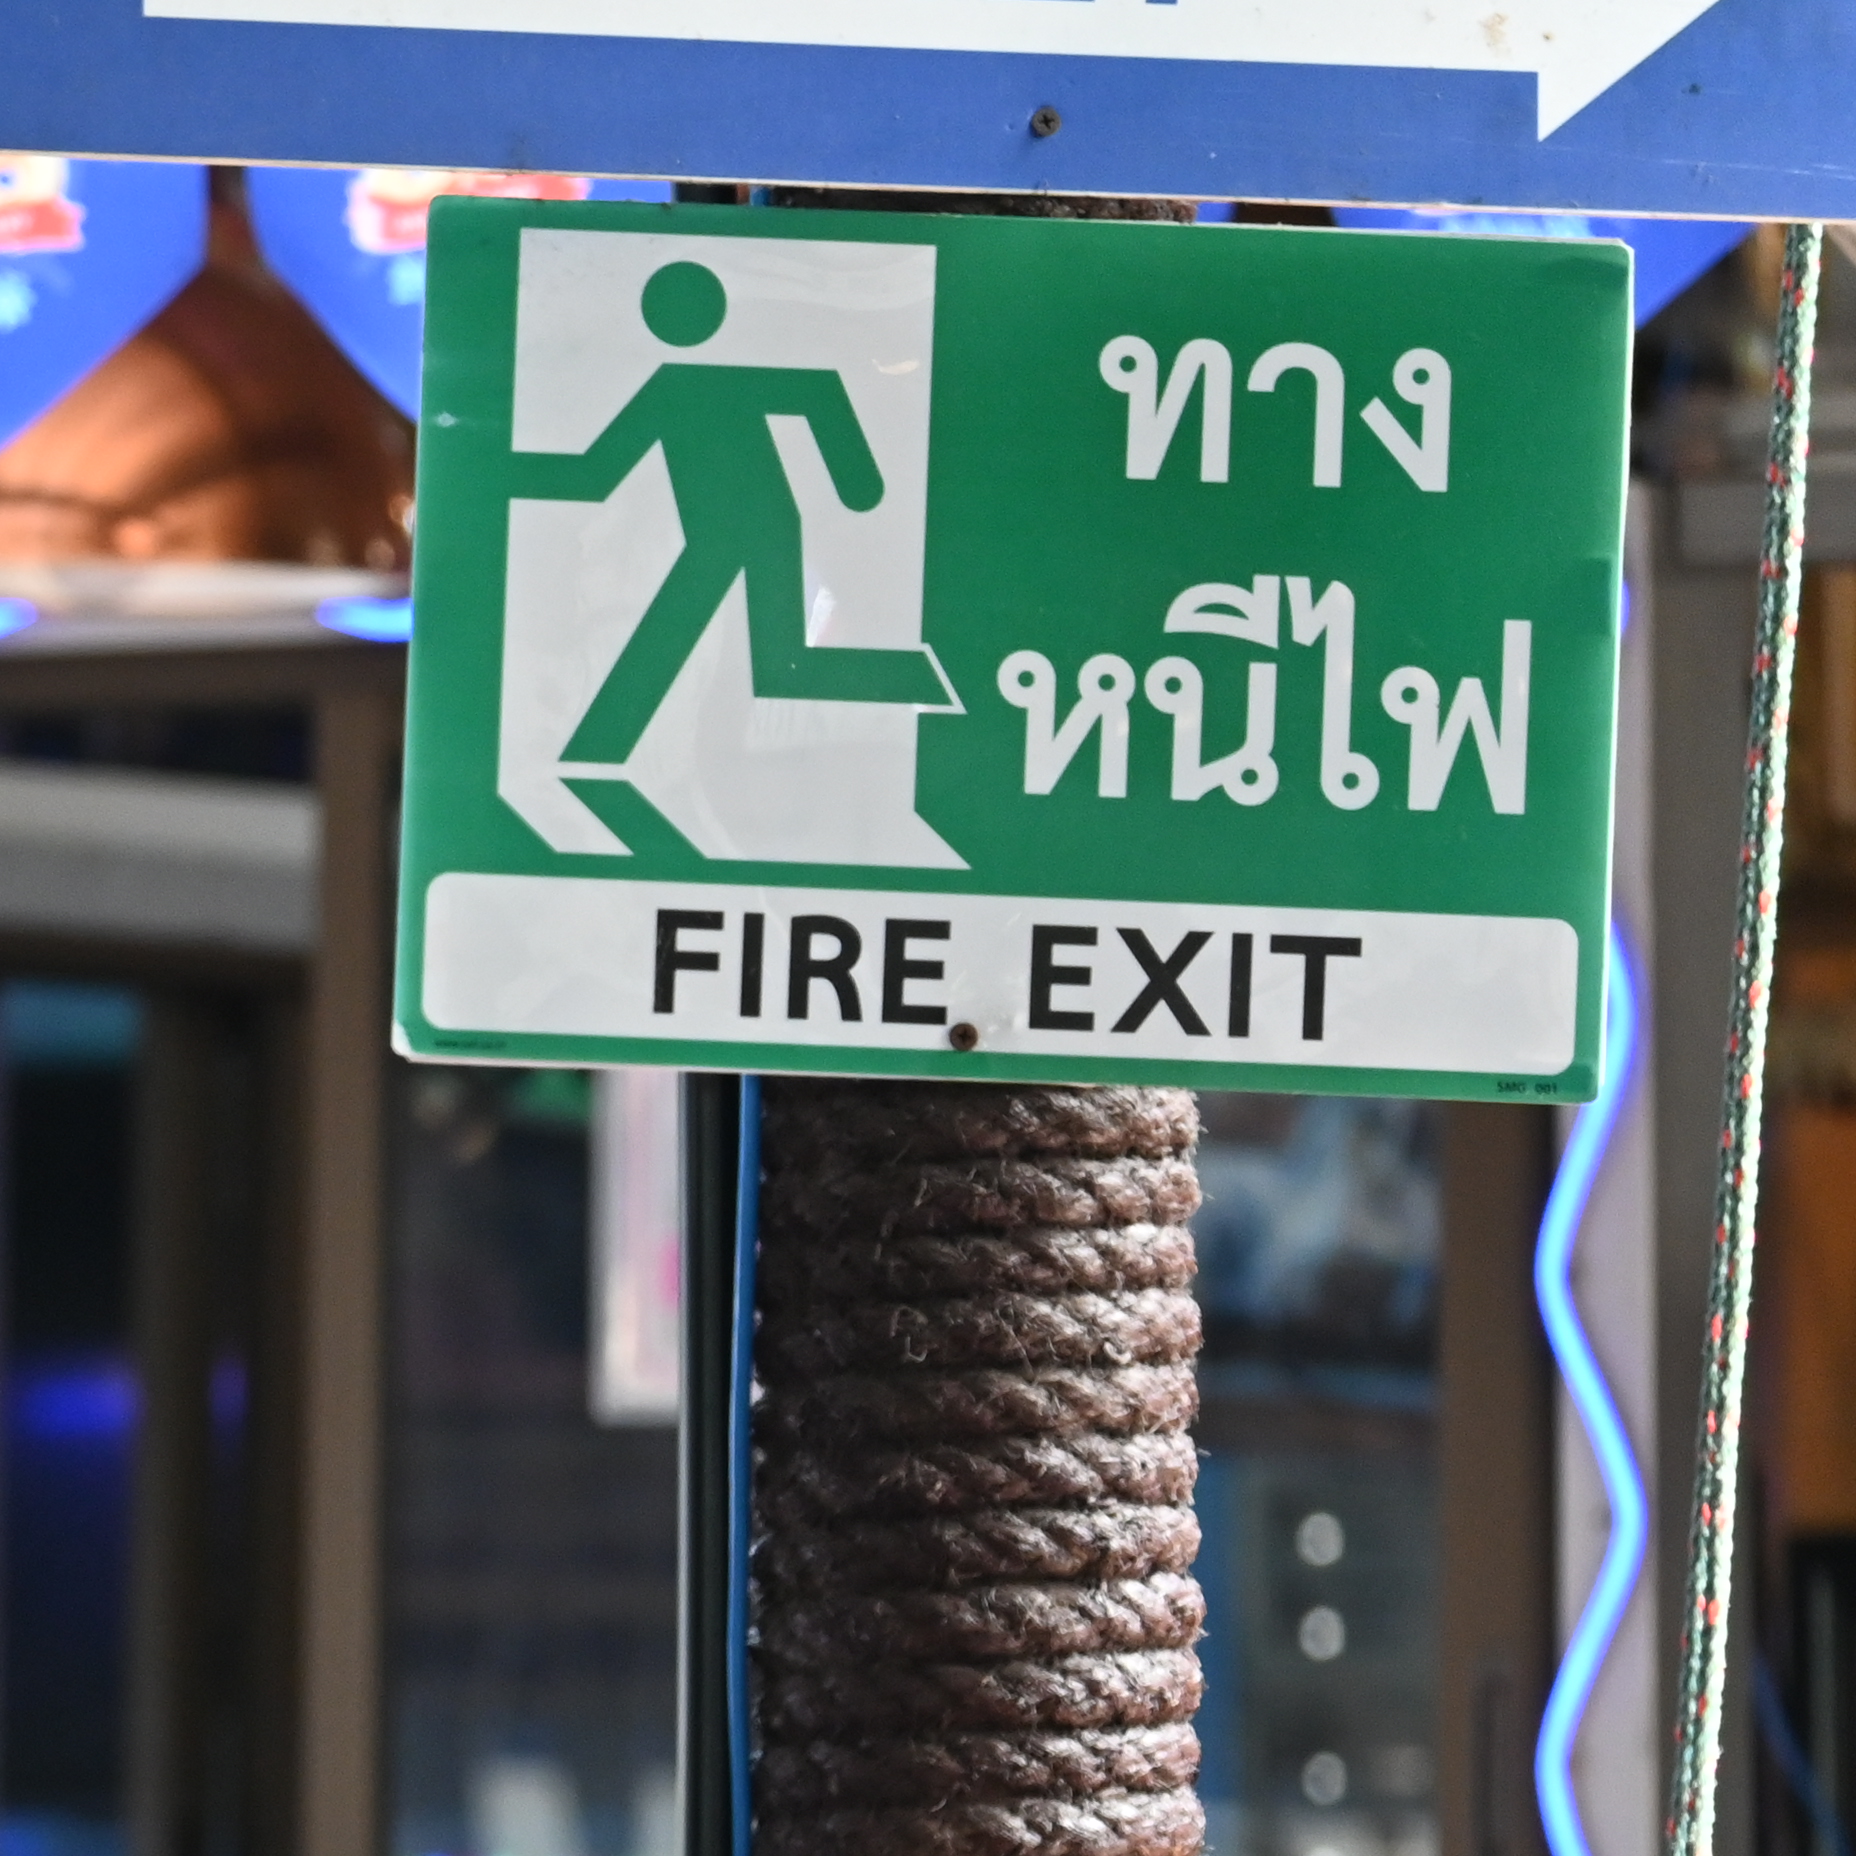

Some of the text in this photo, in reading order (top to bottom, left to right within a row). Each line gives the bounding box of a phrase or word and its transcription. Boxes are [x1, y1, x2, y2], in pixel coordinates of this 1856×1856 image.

[1100, 335, 1452, 493] ทาง
[996, 574, 1532, 816] หนีไฟ
[653, 909, 1363, 1042] FIRE EXIT
